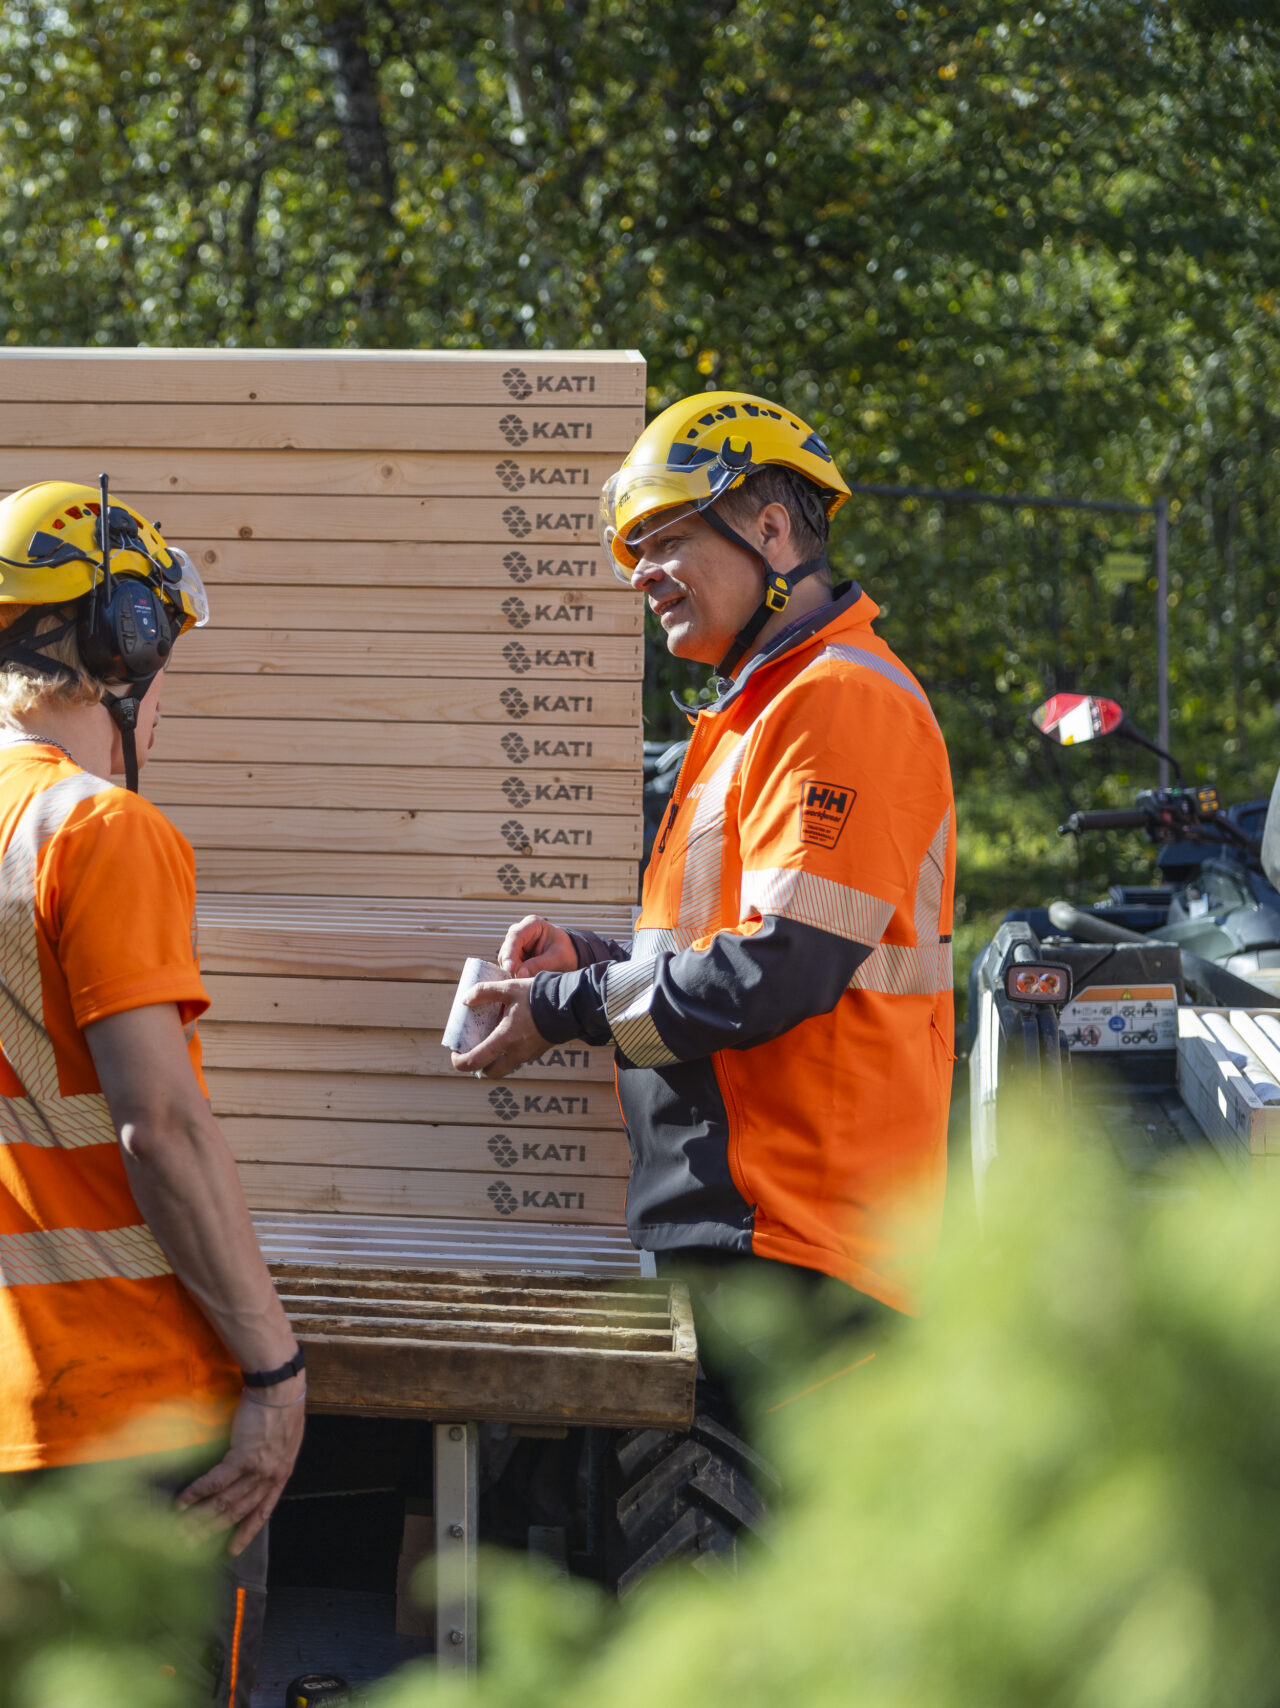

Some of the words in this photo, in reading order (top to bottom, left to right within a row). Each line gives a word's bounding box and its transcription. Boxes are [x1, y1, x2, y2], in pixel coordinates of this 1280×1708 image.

[536, 376, 596, 392] KATI
[532, 422, 592, 439] KATI
[529, 467, 589, 485] KATI
[536, 513, 594, 530] KATI
[537, 559, 596, 577] KATI
[535, 604, 593, 622] KATI
[535, 649, 594, 667] KATI
[533, 695, 592, 712] KATI
[533, 740, 592, 757] KATI
[535, 784, 593, 801] KATI
[807, 786, 847, 813] HH
[533, 828, 592, 845] KATI
[530, 872, 588, 889] KATI
[524, 1095, 588, 1114] KATI
[523, 1143, 586, 1162] KATI
[523, 1190, 584, 1209] KATI
